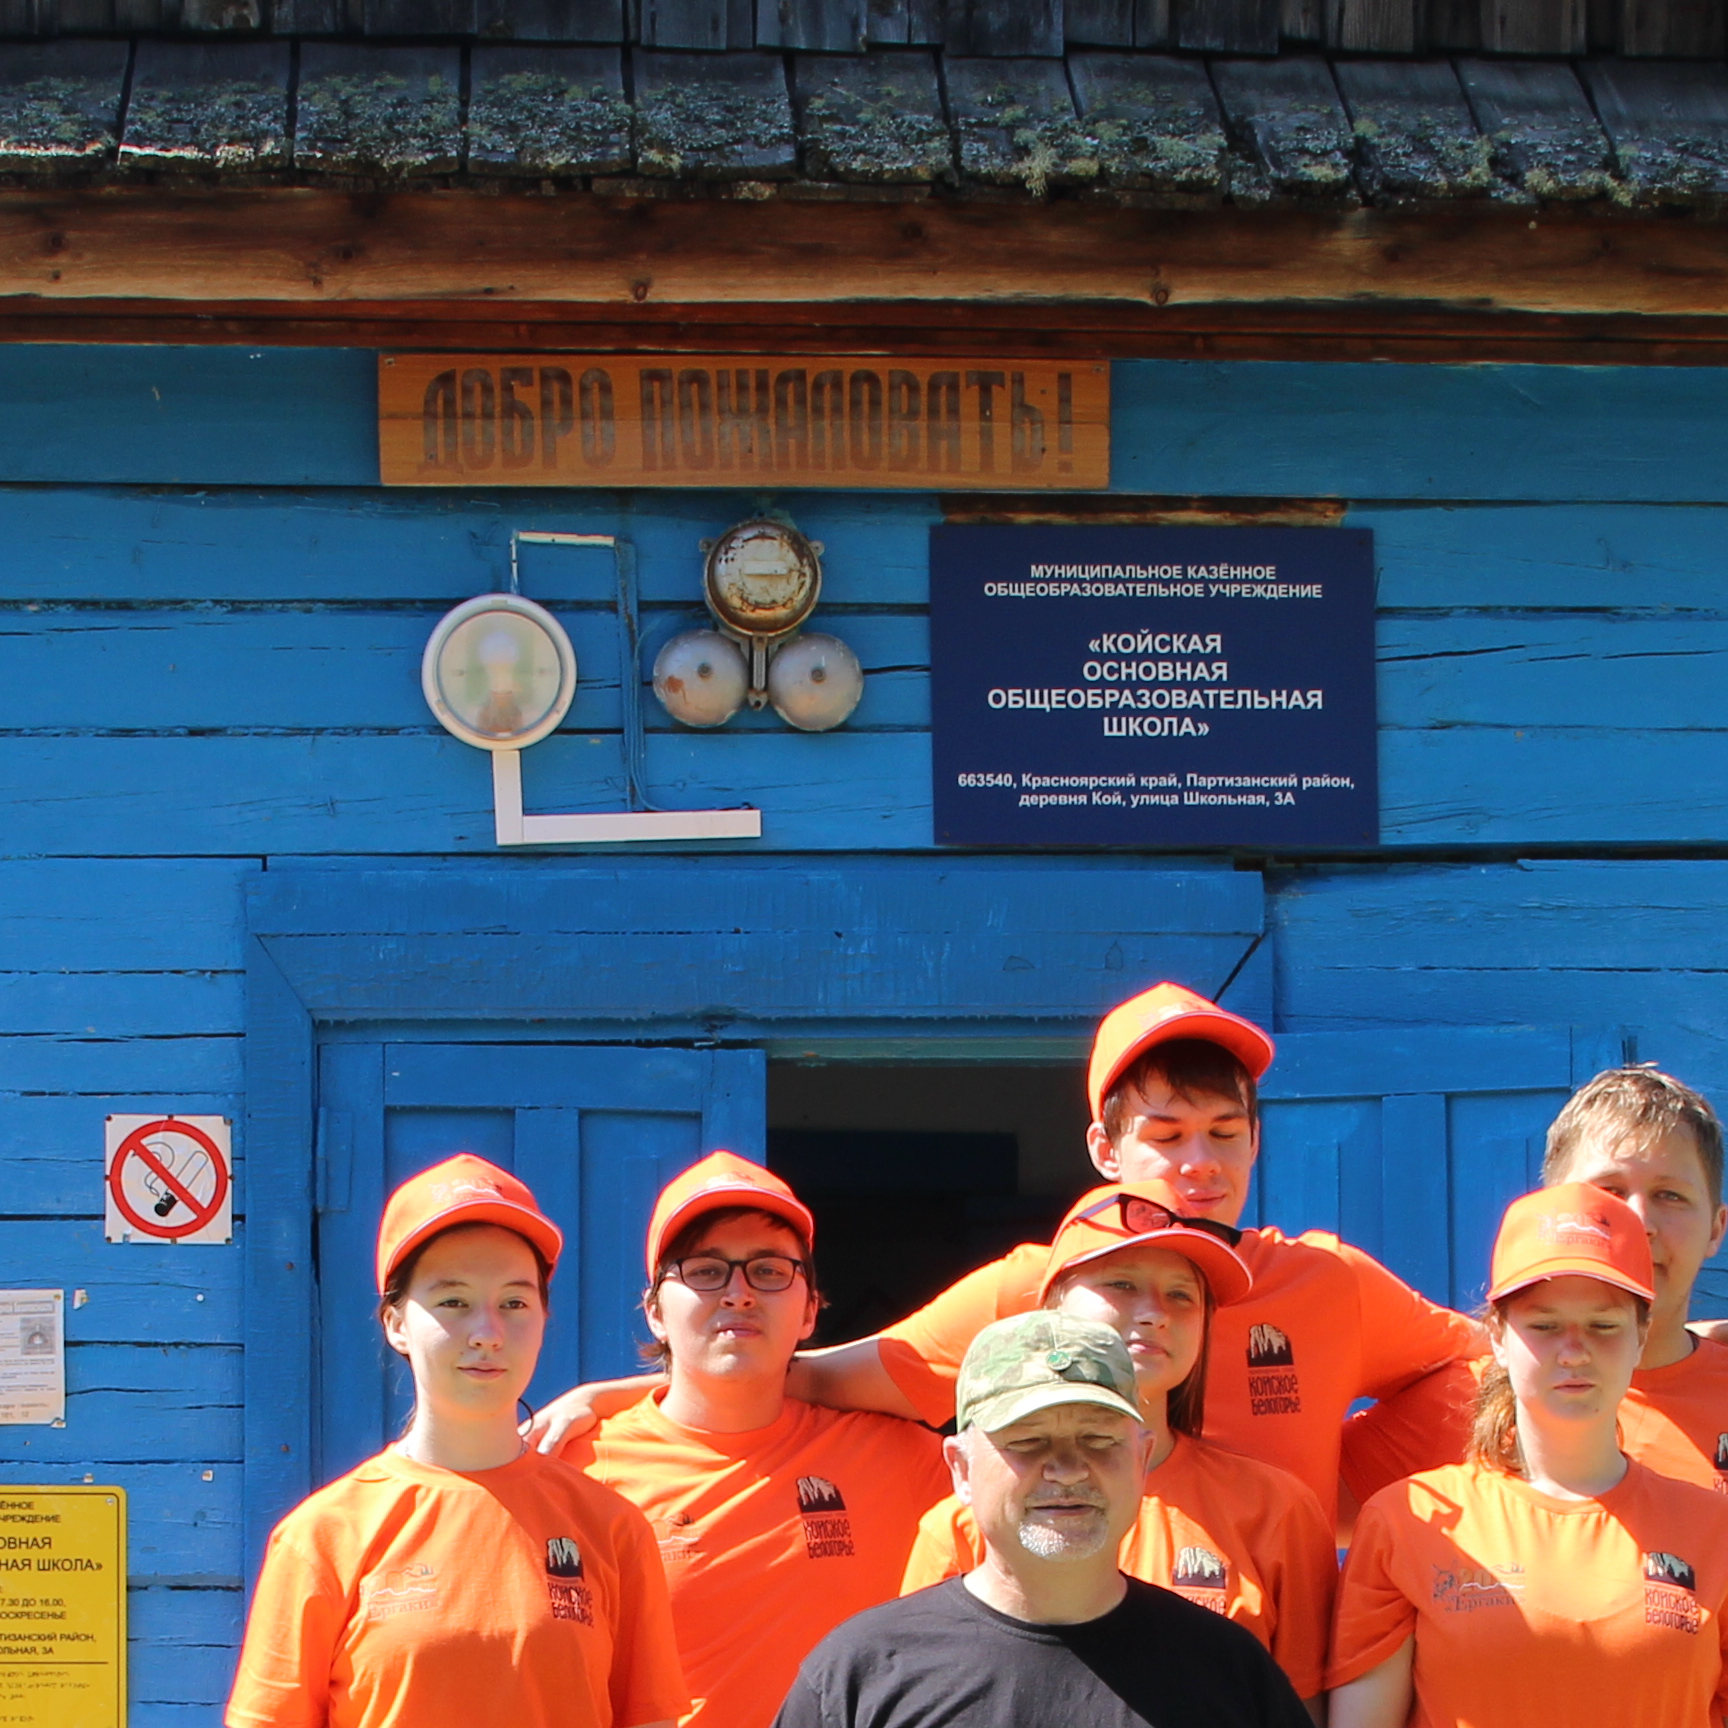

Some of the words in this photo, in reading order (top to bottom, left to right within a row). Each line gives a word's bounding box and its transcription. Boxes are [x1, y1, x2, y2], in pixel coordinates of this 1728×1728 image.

[416, 367, 616, 474] ДОБРО
[639, 368, 1074, 473] ПОЖАЛОВАТЬ!
[1031, 565, 1182, 580] МУНИЦИПАЛЬНОЕ
[1188, 563, 1276, 579] КАЗЁННОЕ
[984, 583, 1204, 598] ОБЩЕОБРАЗОВАТЕЛЬНОЕ
[1209, 584, 1322, 599] УЧРЕЖДЕНИЕ
[1089, 629, 1221, 653] «КОЙСКАЯ
[1083, 661, 1227, 681] ОСНОВНАЯ
[988, 689, 1322, 712] ОБЩЕОБРАЗОВАТЕЛЬНАЯ
[1104, 717, 1209, 736] ШКОЛА»
[958, 774, 1016, 788] 663540,
[1022, 774, 1135, 789] Красноярский
[1141, 774, 1181, 789] край,
[1187, 774, 1297, 789] Партизанский
[1303, 774, 1354, 790] район,
[1019, 795, 1087, 808] деревня
[1092, 791, 1126, 806] Кой,
[1131, 794, 1178, 808] улица
[1184, 792, 1269, 807] Школьная,
[1275, 792, 1295, 805] 3А
[36, 1558, 103, 1572] ШКОЛА»
